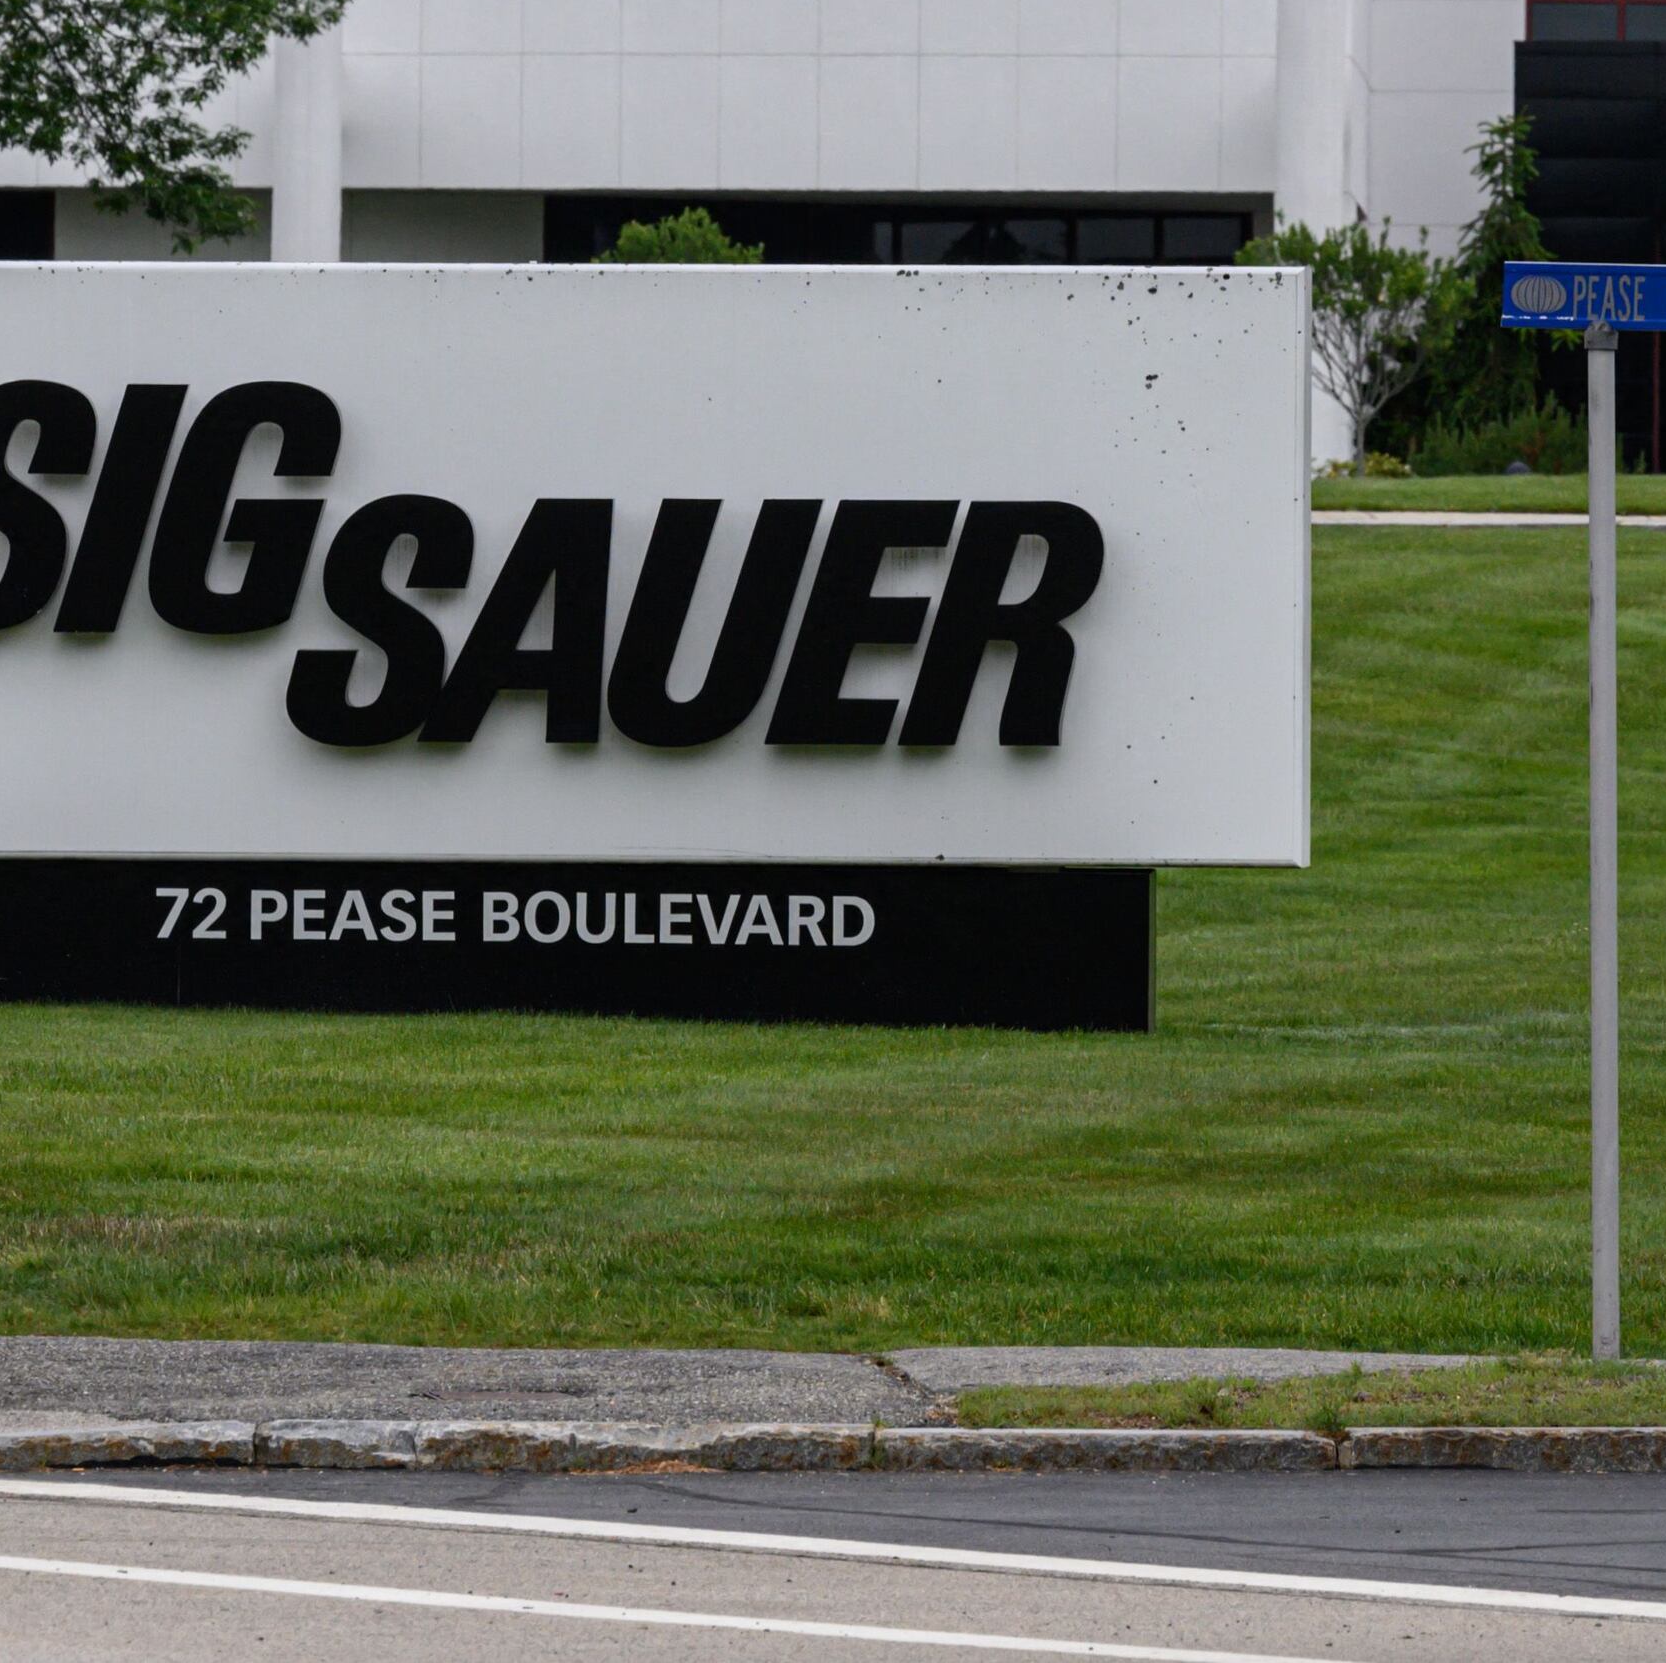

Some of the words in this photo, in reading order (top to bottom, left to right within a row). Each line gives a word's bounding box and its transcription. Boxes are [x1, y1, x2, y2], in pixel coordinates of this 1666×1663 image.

[1573, 274, 1646, 321] PEASE
[286, 493, 1105, 747] SAUER
[155, 887, 227, 939] 72
[250, 889, 456, 942] PEASE
[482, 891, 876, 947] BOULEVARD
